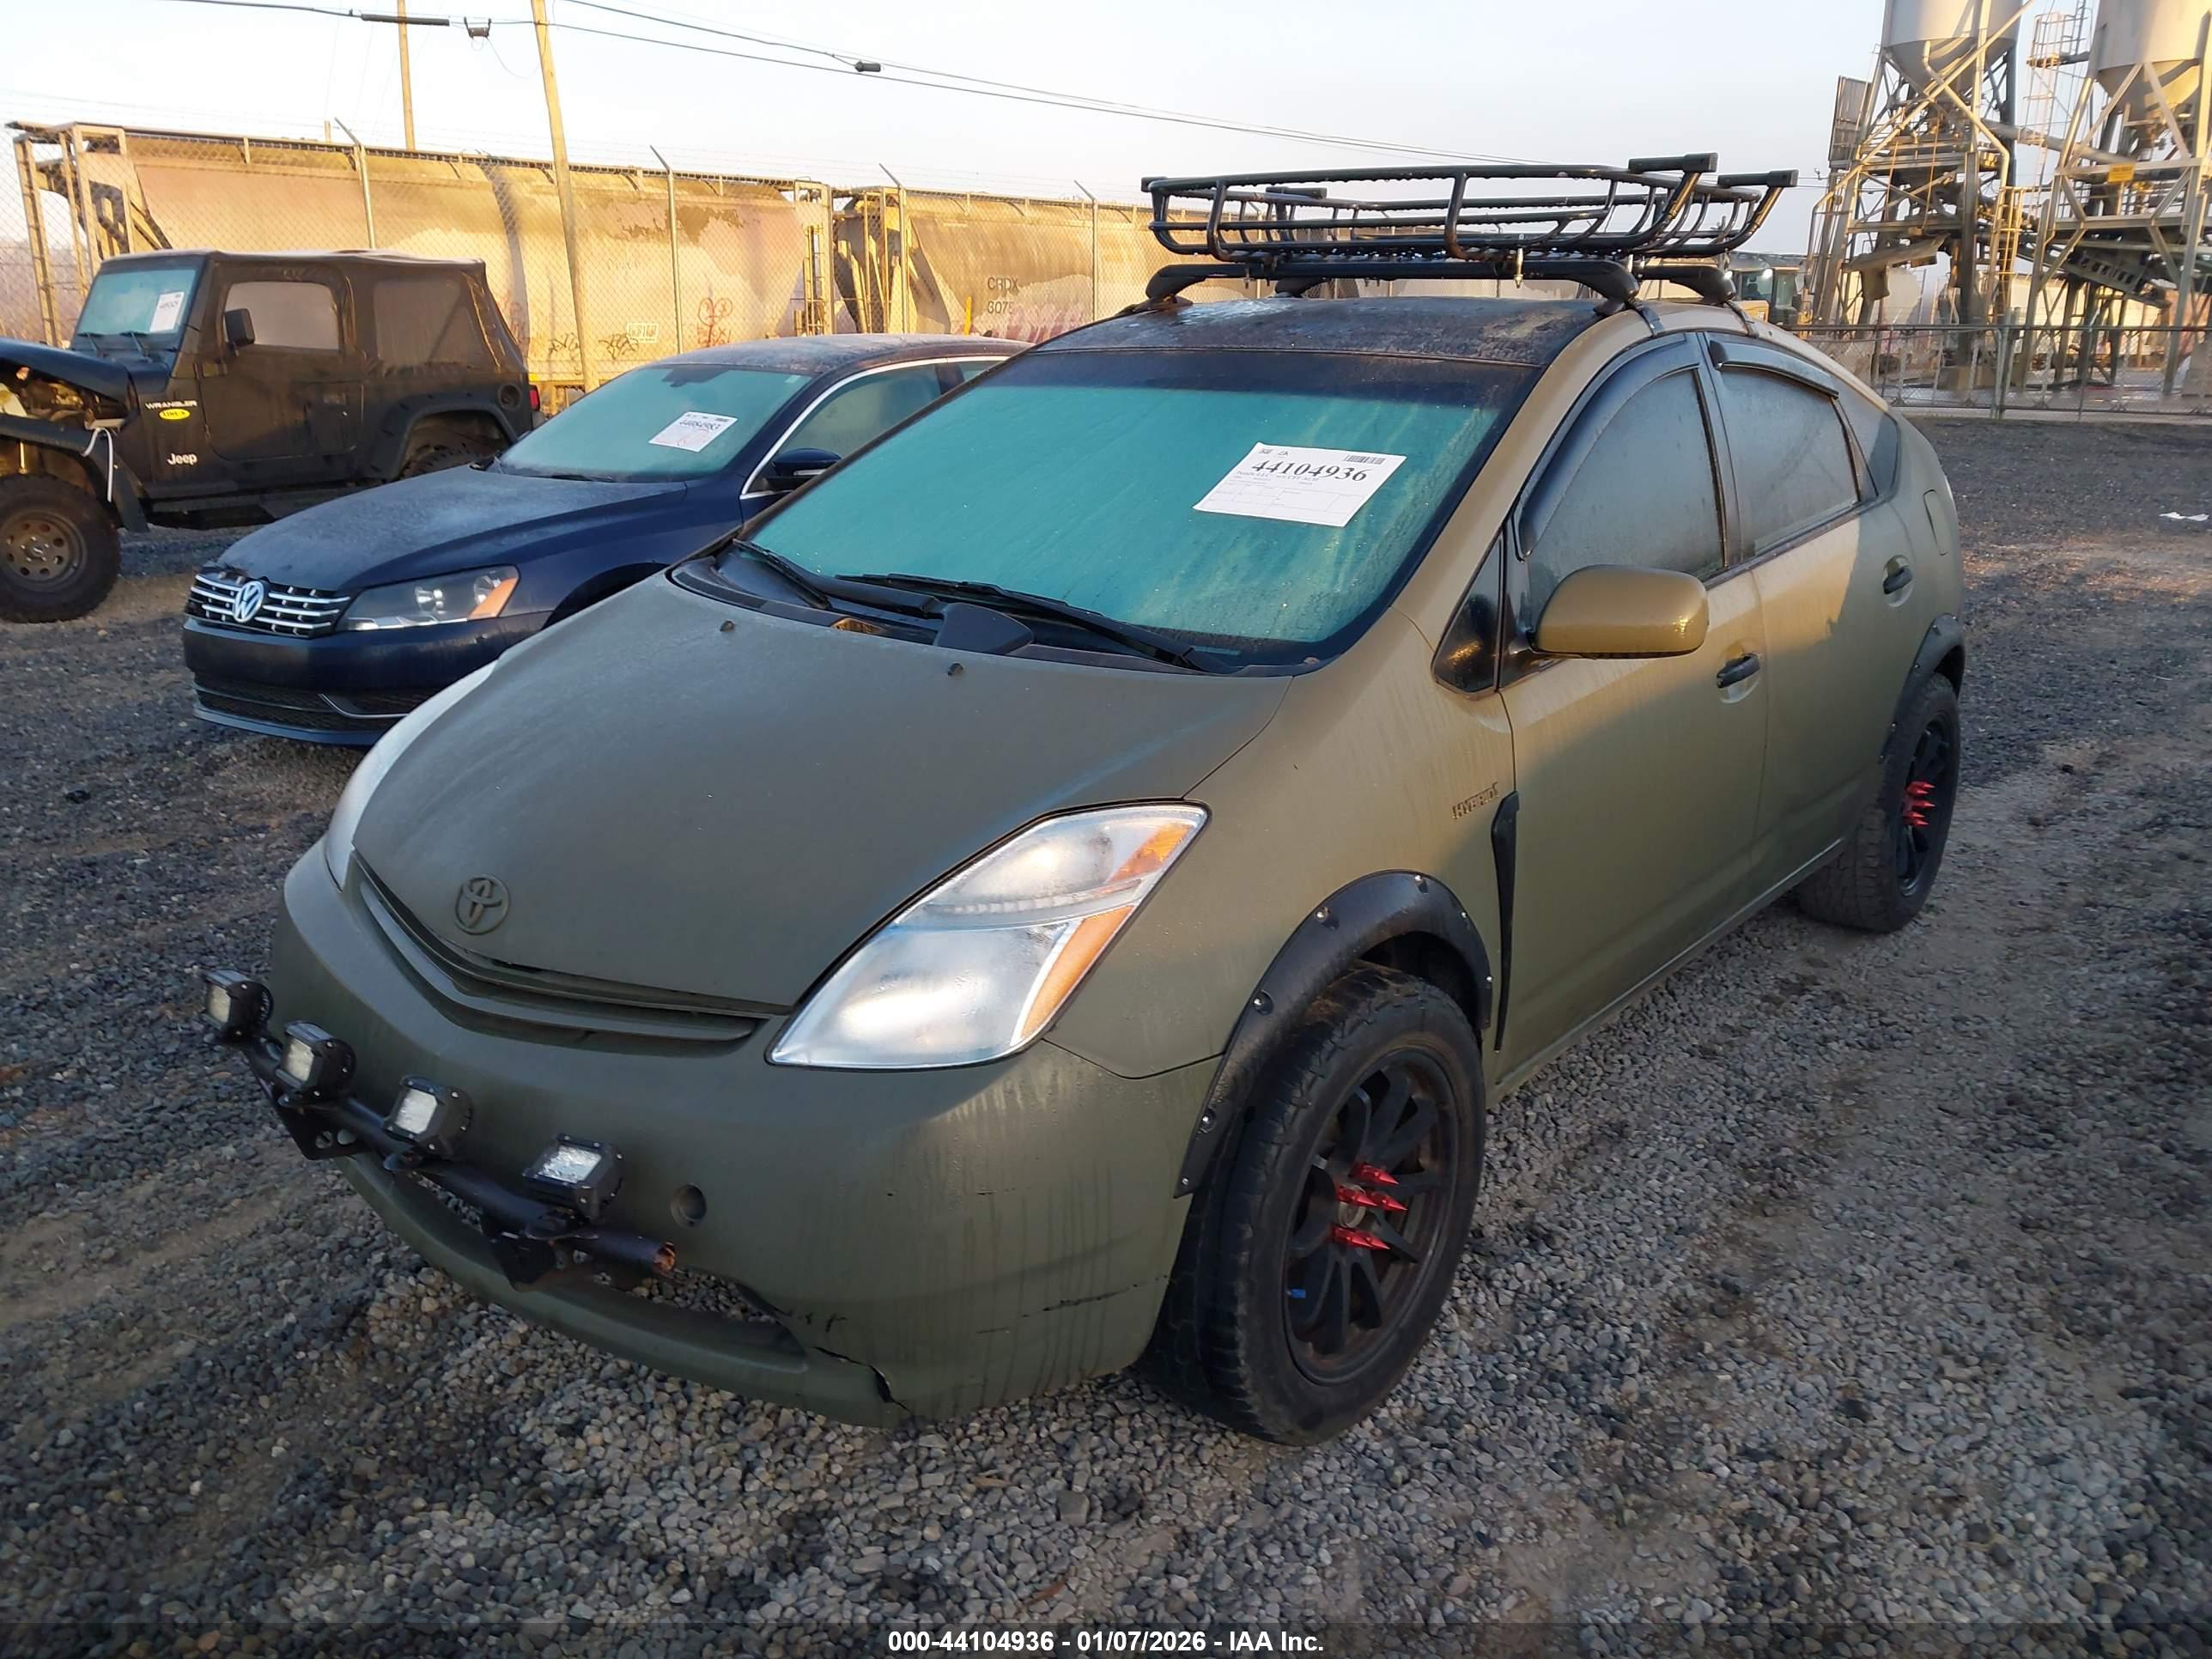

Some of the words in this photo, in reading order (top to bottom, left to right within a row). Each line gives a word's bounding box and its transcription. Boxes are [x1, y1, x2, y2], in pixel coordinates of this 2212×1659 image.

[988, 276, 1018, 291] CRDX
[145, 400, 198, 410] WRANGLER
[167, 453, 198, 465] Jeep
[1252, 459, 1371, 481] 44104936
